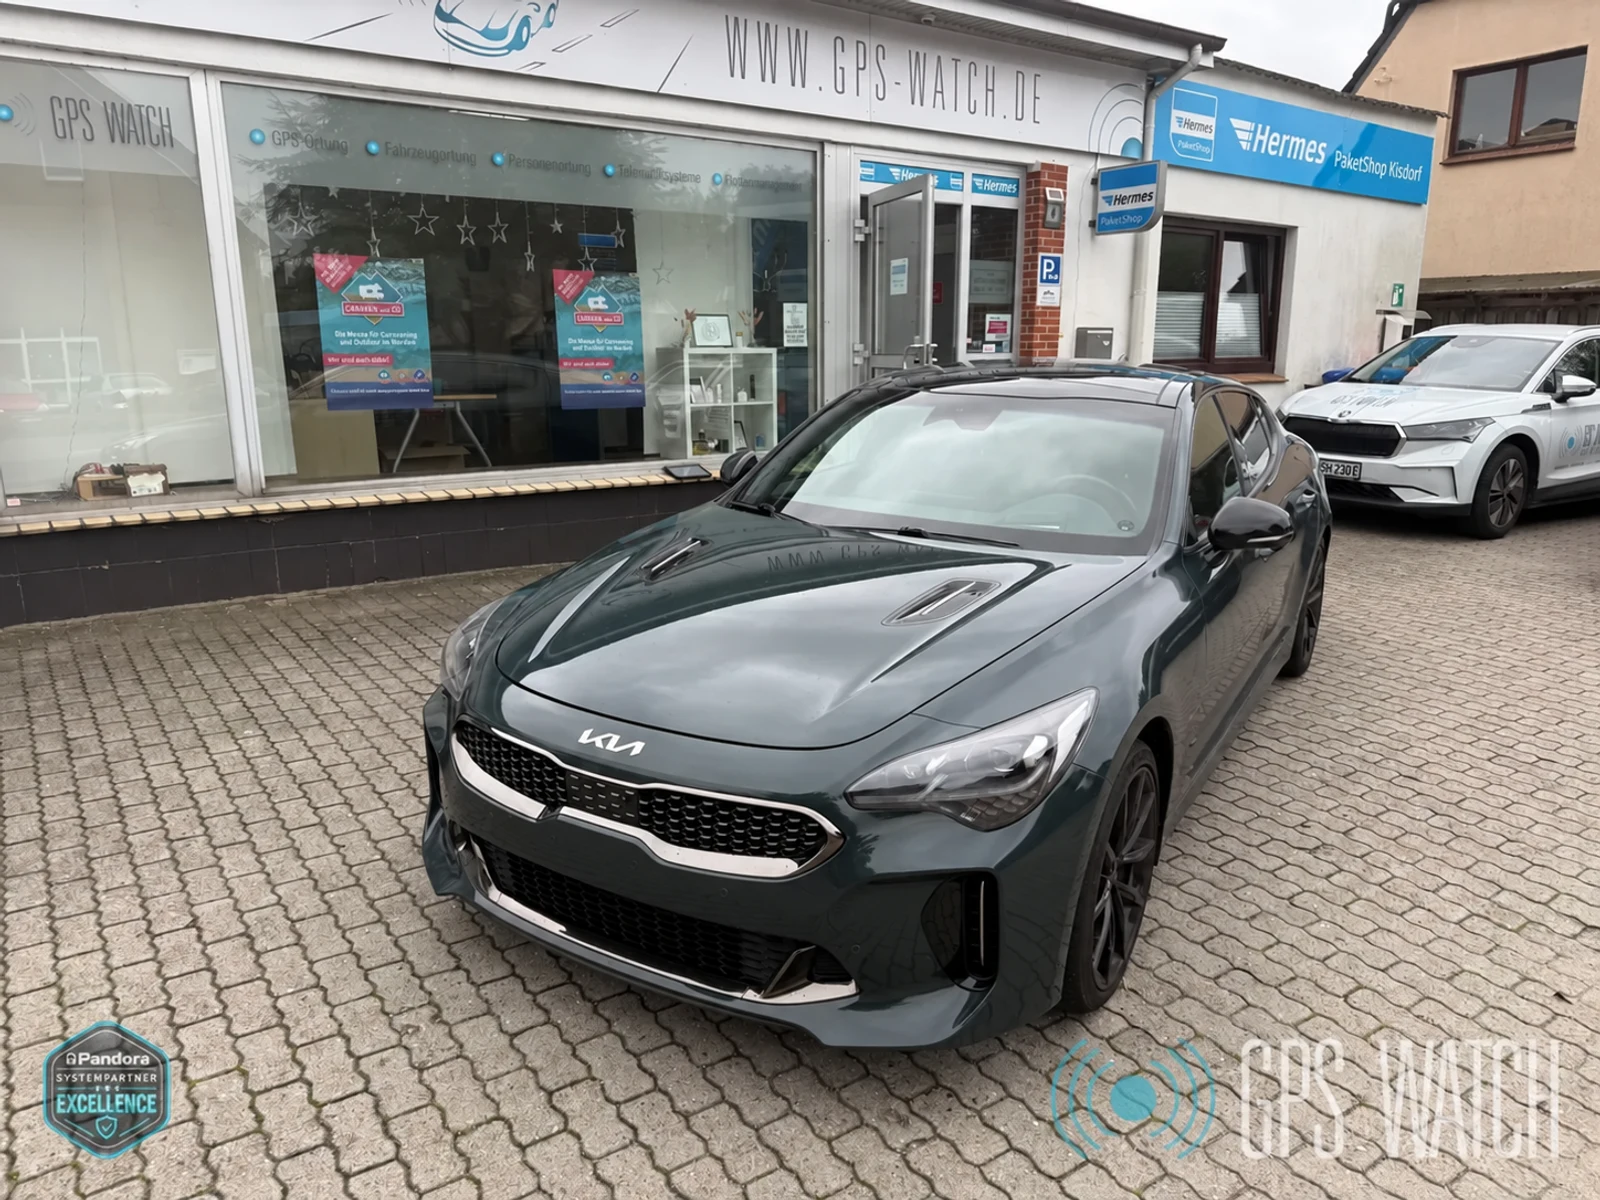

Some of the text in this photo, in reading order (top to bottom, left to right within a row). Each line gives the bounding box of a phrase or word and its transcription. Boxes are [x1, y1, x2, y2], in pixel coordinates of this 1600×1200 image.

[725, 15, 1041, 124] WWW.GPS-WATCH.DE
[50, 96, 174, 148] GPS WATCH
[1184, 118, 1214, 134] Hermes
[271, 129, 348, 156] GPS-Ortung
[384, 141, 477, 167] Fahrzeugortung
[1252, 123, 1327, 164] Hermes
[508, 153, 592, 177] Personenortung
[1334, 150, 1424, 182] PaketShop Kisdorf
[983, 177, 1018, 194] Hermes
[1113, 190, 1154, 206] Hermes
[1101, 215, 1143, 226] PaketShop
[1043, 258, 1055, 280] P
